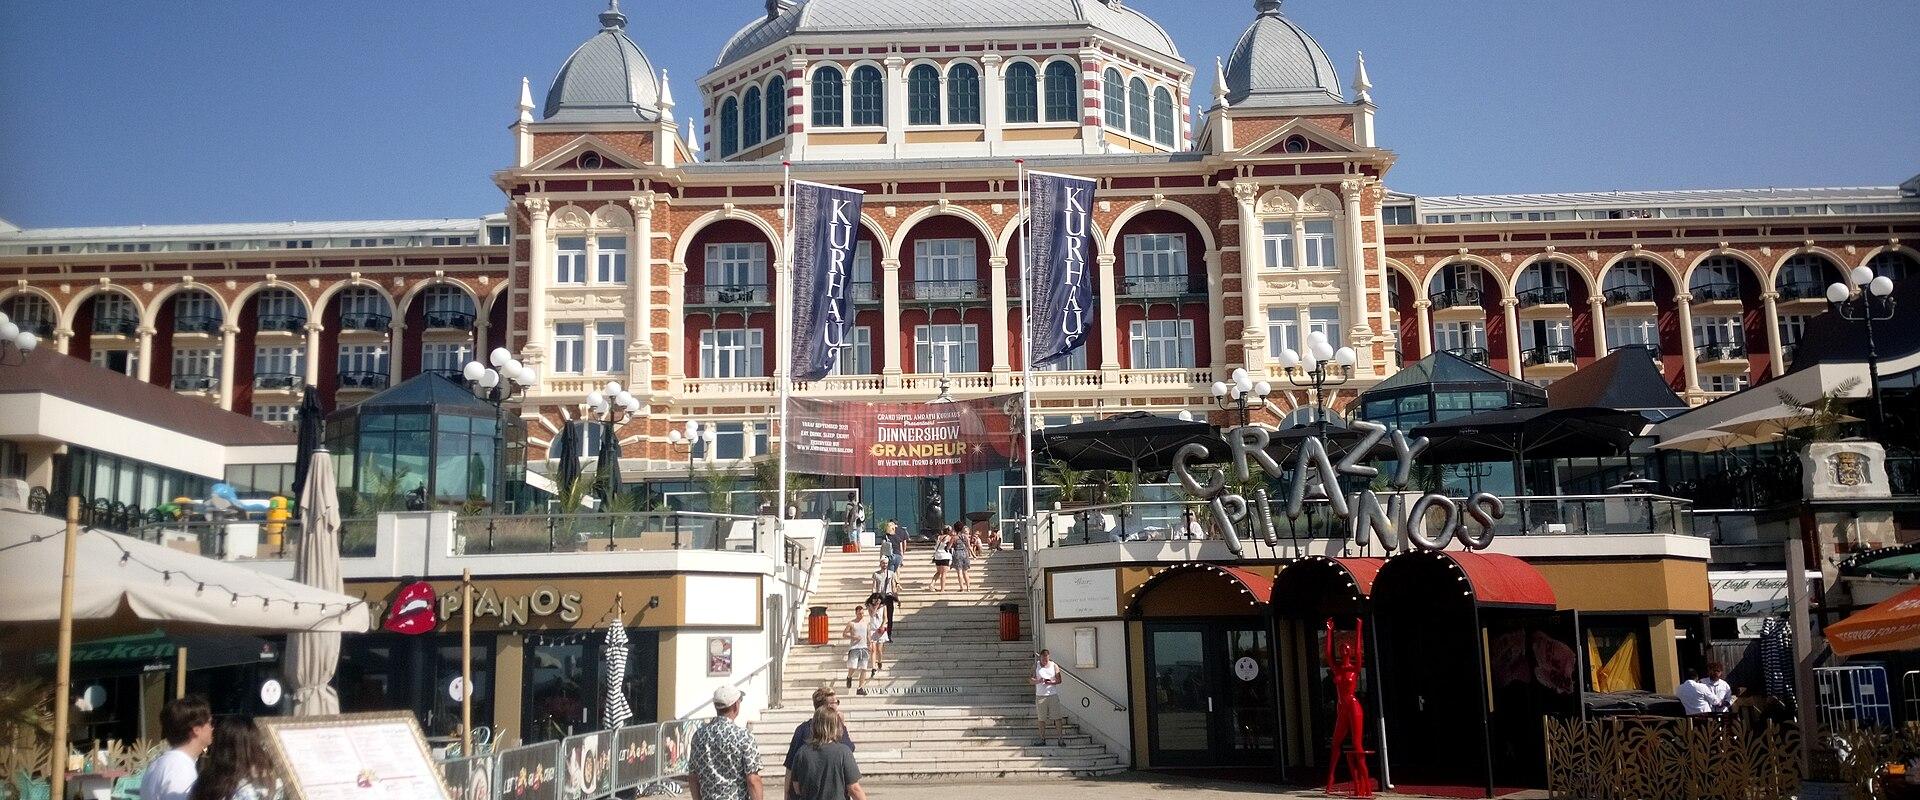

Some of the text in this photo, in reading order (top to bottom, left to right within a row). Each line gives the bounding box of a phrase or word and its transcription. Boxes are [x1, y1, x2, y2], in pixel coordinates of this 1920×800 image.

[1060, 186, 1087, 349] KURHAUS
[877, 413, 895, 421] GRAND
[878, 425, 960, 442] DINNERSHOW
[872, 441, 967, 457] GRANDEUR
[1172, 420, 1430, 521] CRAZY
[920, 686, 959, 694] KURHAUS
